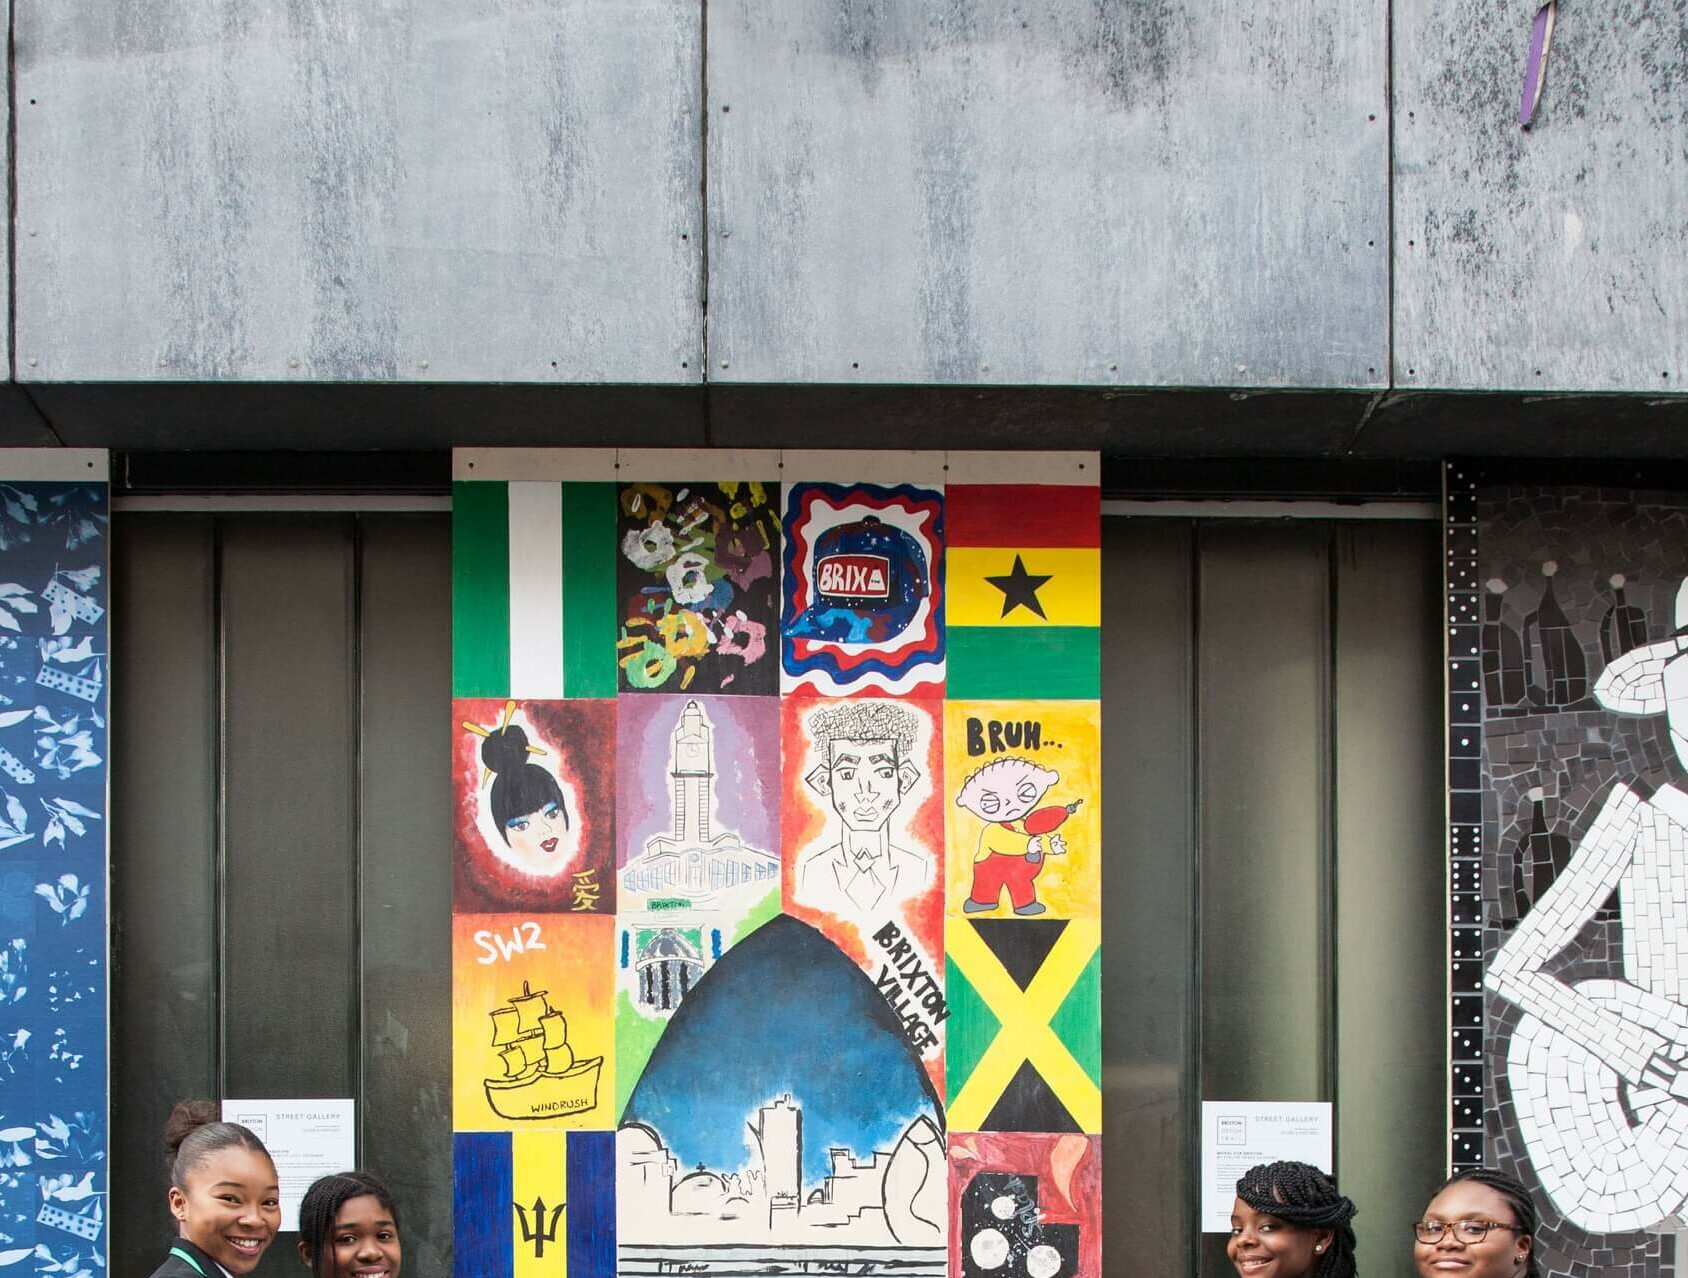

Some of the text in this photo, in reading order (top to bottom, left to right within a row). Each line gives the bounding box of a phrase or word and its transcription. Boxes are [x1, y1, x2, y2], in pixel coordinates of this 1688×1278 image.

[474, 922, 547, 964] SW2
[872, 920, 951, 1025] BRIXTON
[876, 963, 939, 1056] VILLAGE
[275, 1113, 340, 1121] STREET GALLERY
[531, 1098, 588, 1113] WINDRUSH
[1255, 1115, 1283, 1123] STREET
